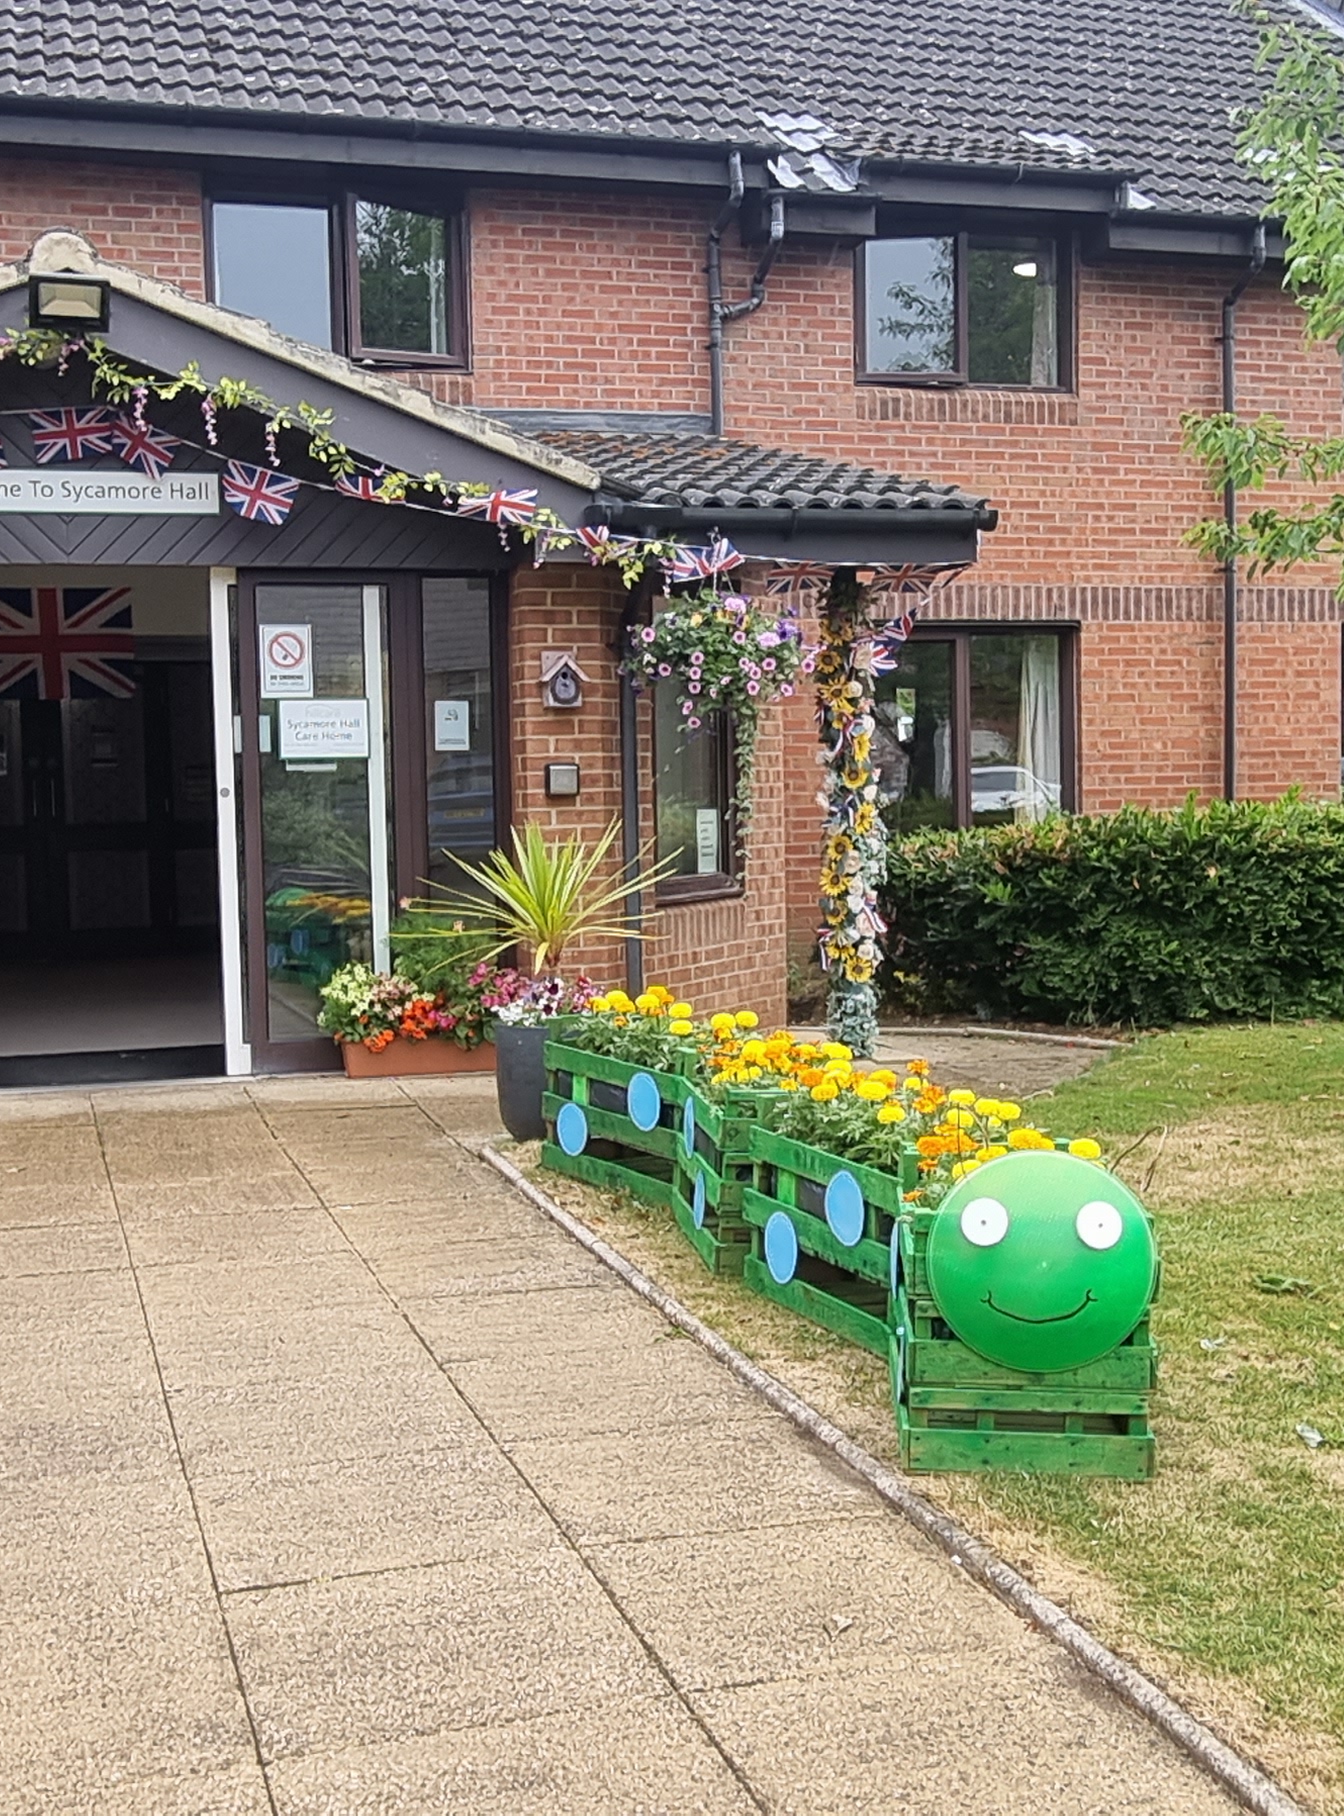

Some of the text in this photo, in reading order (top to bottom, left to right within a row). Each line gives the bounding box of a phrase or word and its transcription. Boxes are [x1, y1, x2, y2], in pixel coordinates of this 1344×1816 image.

[28, 480, 54, 498] To
[60, 480, 162, 503] Sycamore
[170, 482, 209, 500] Hall
[287, 718, 360, 731] Sycamore Hall
[295, 731, 353, 741] Care Home
